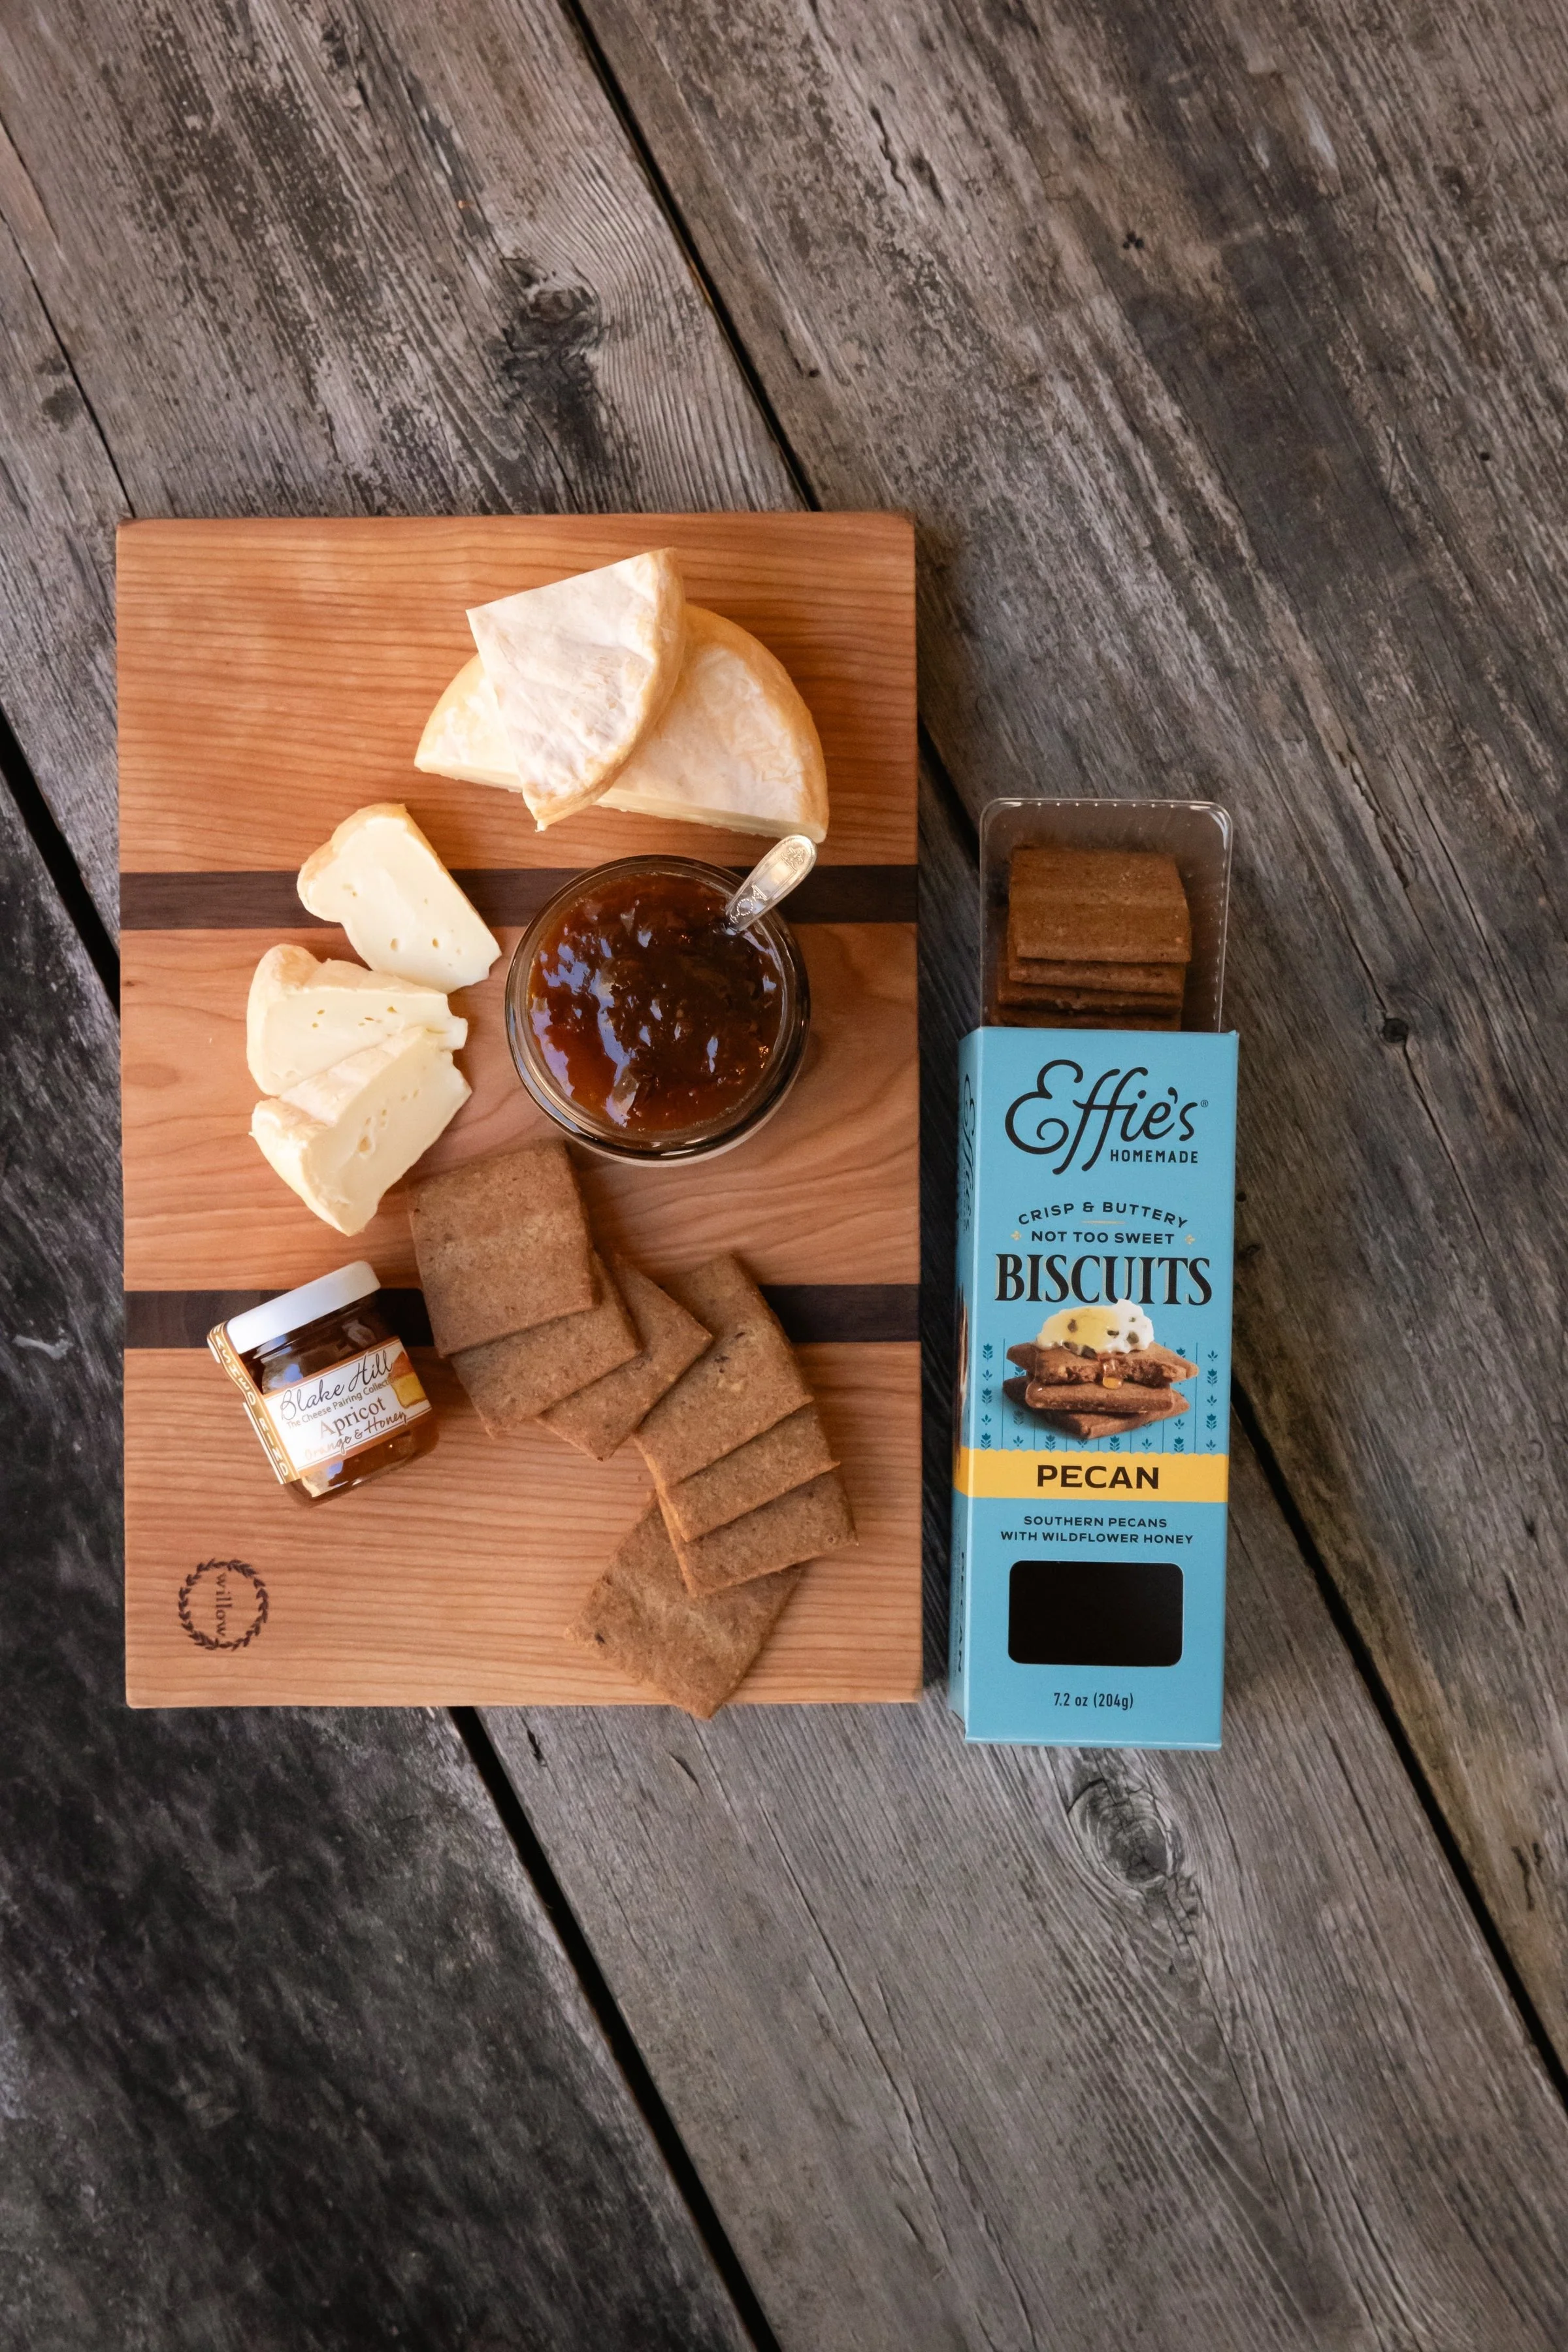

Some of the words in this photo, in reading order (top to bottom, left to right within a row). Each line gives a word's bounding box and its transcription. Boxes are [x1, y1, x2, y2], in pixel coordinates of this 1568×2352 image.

[1110, 1149, 1199, 1164] HOMEMADE
[1018, 1203, 1075, 1226] CRISP
[1083, 1201, 1095, 1213] &
[1102, 1201, 1188, 1228] BUTTERY
[1031, 1230, 1068, 1242] NOT
[1073, 1231, 1109, 1243] TOO
[1114, 1232, 1175, 1245] SWEET
[994, 1253, 1213, 1306] BISCUITS
[280, 1379, 345, 1421] Blake
[348, 1350, 393, 1392] Hill
[286, 1419, 301, 1429] The
[302, 1406, 332, 1423] Cheese
[332, 1393, 363, 1411] Pairing
[319, 1397, 387, 1439] Apricot
[354, 1429, 364, 1440] &
[363, 1410, 408, 1435] Honey
[1036, 1464, 1160, 1490] PECAN
[1023, 1516, 1104, 1527] SOUTHERN
[1108, 1517, 1168, 1527] PECANS
[1000, 1531, 1037, 1541] WITH
[1042, 1532, 1139, 1543] WILDFLOWER
[1143, 1534, 1194, 1544] HONEY
[215, 1572, 233, 1637] willow
[1053, 1691, 1071, 1707] 7.2
[1075, 1695, 1088, 1707] oz
[1093, 1693, 1134, 1711] (204g)
